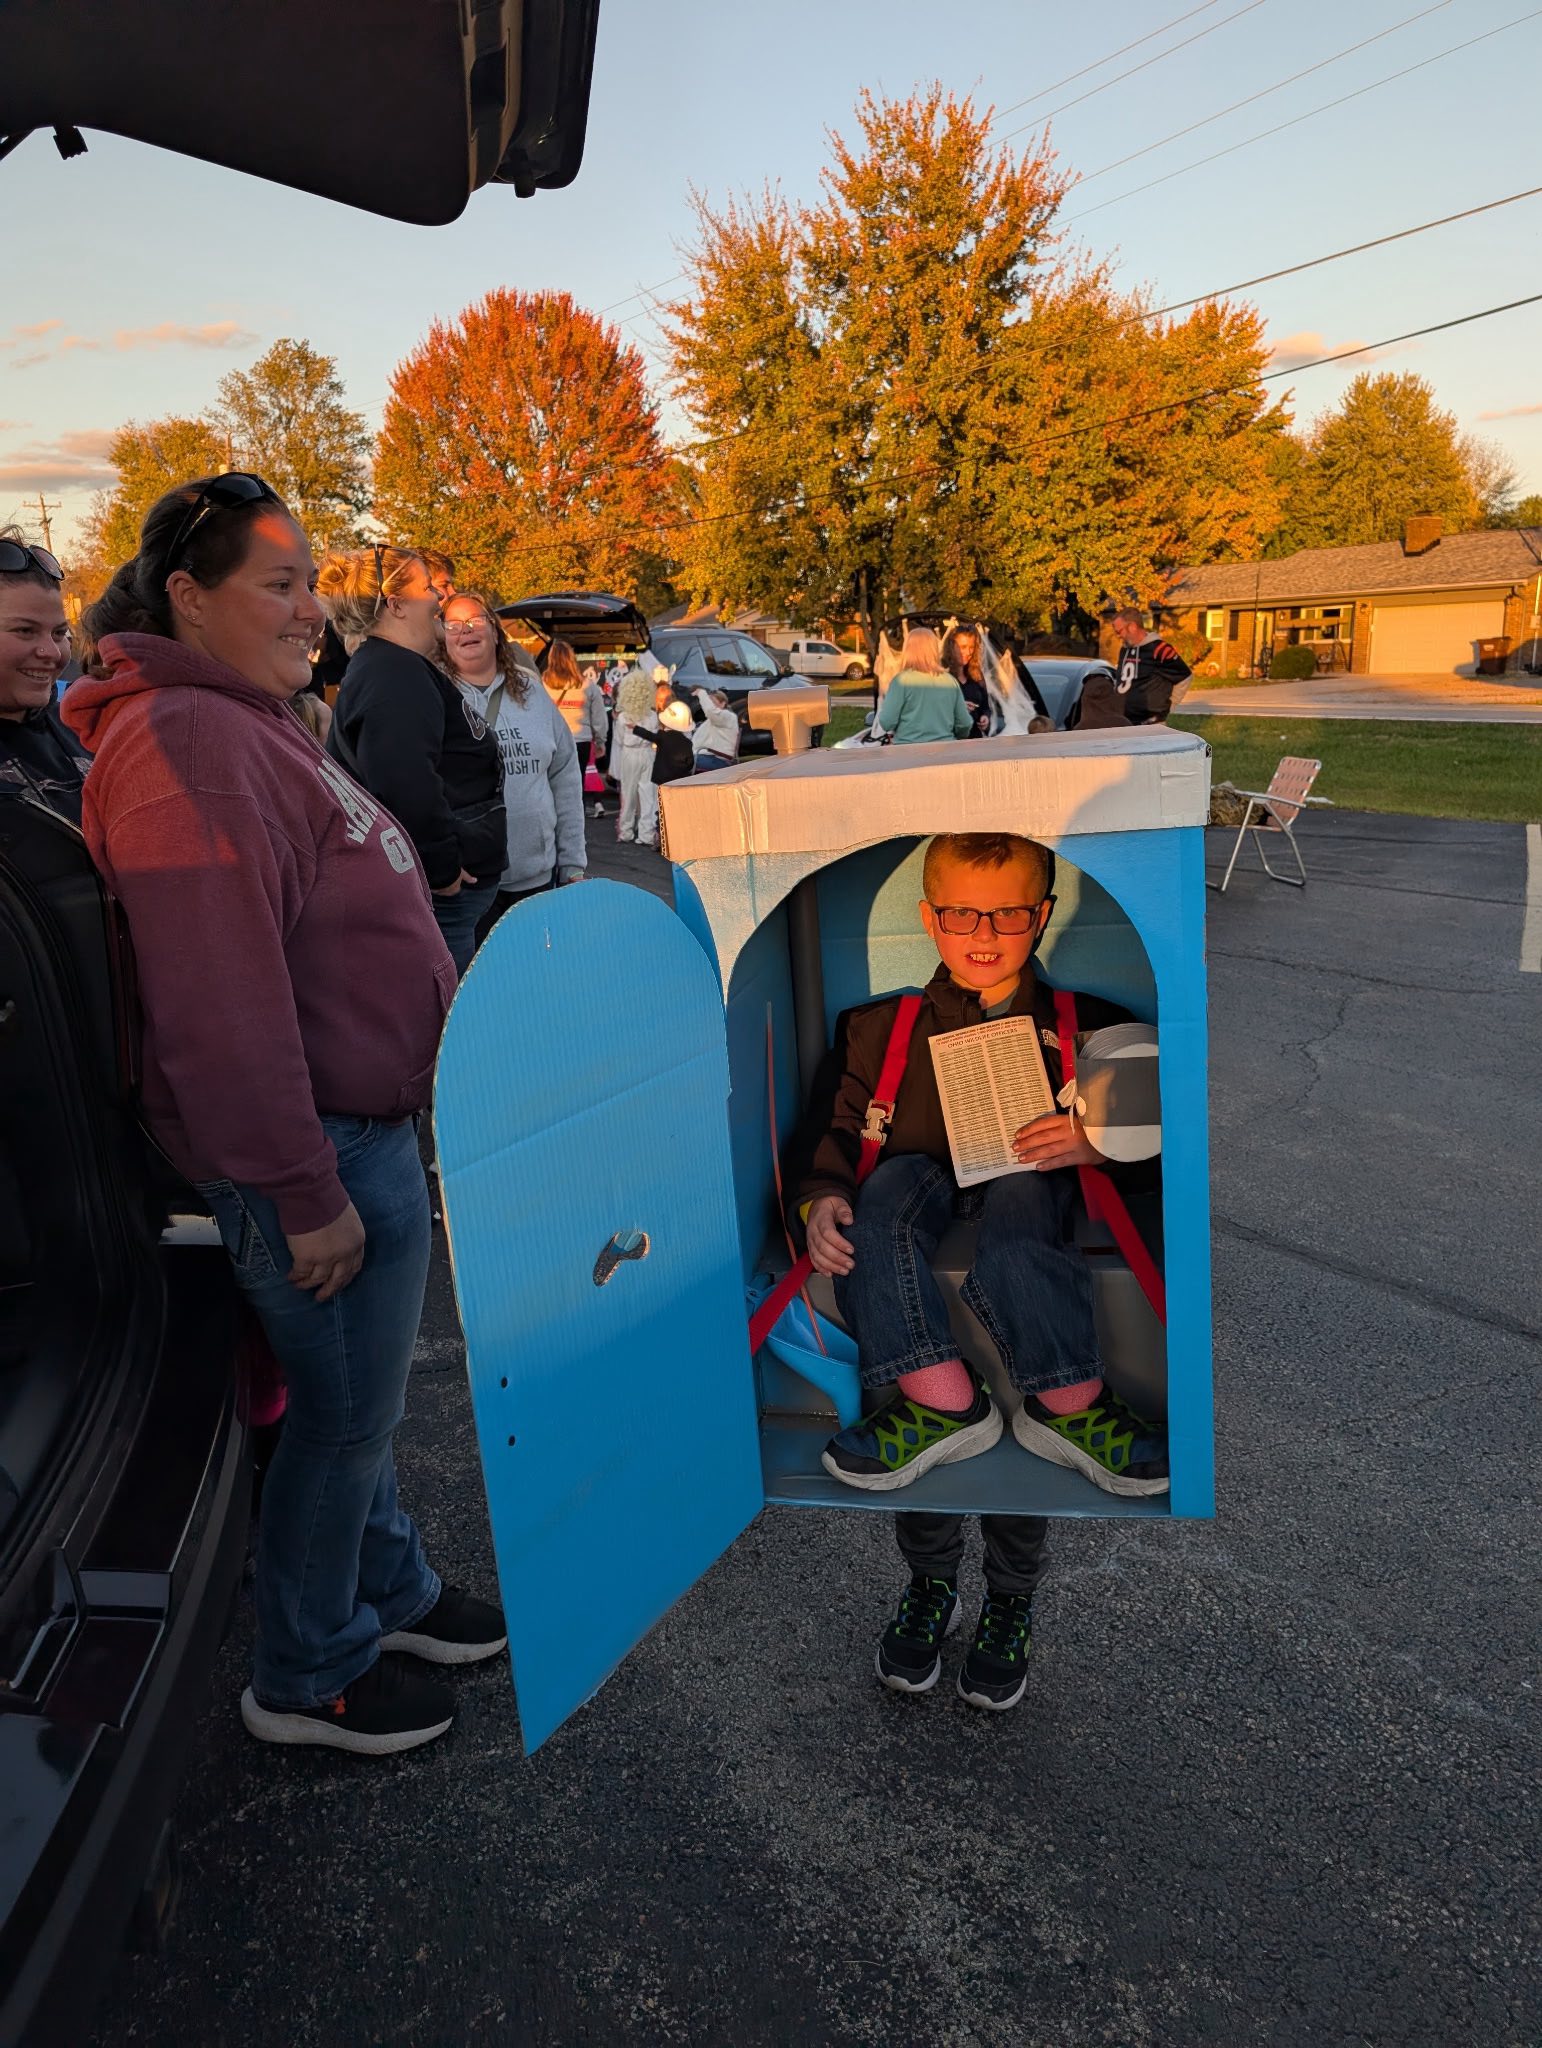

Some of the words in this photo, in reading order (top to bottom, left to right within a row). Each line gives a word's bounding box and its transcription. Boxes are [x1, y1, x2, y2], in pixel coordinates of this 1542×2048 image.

[1116, 662, 1136, 695] 9
[531, 759, 541, 774] IT
[947, 1040, 964, 1049] OHIO
[990, 1027, 1018, 1039] OFFICERS
